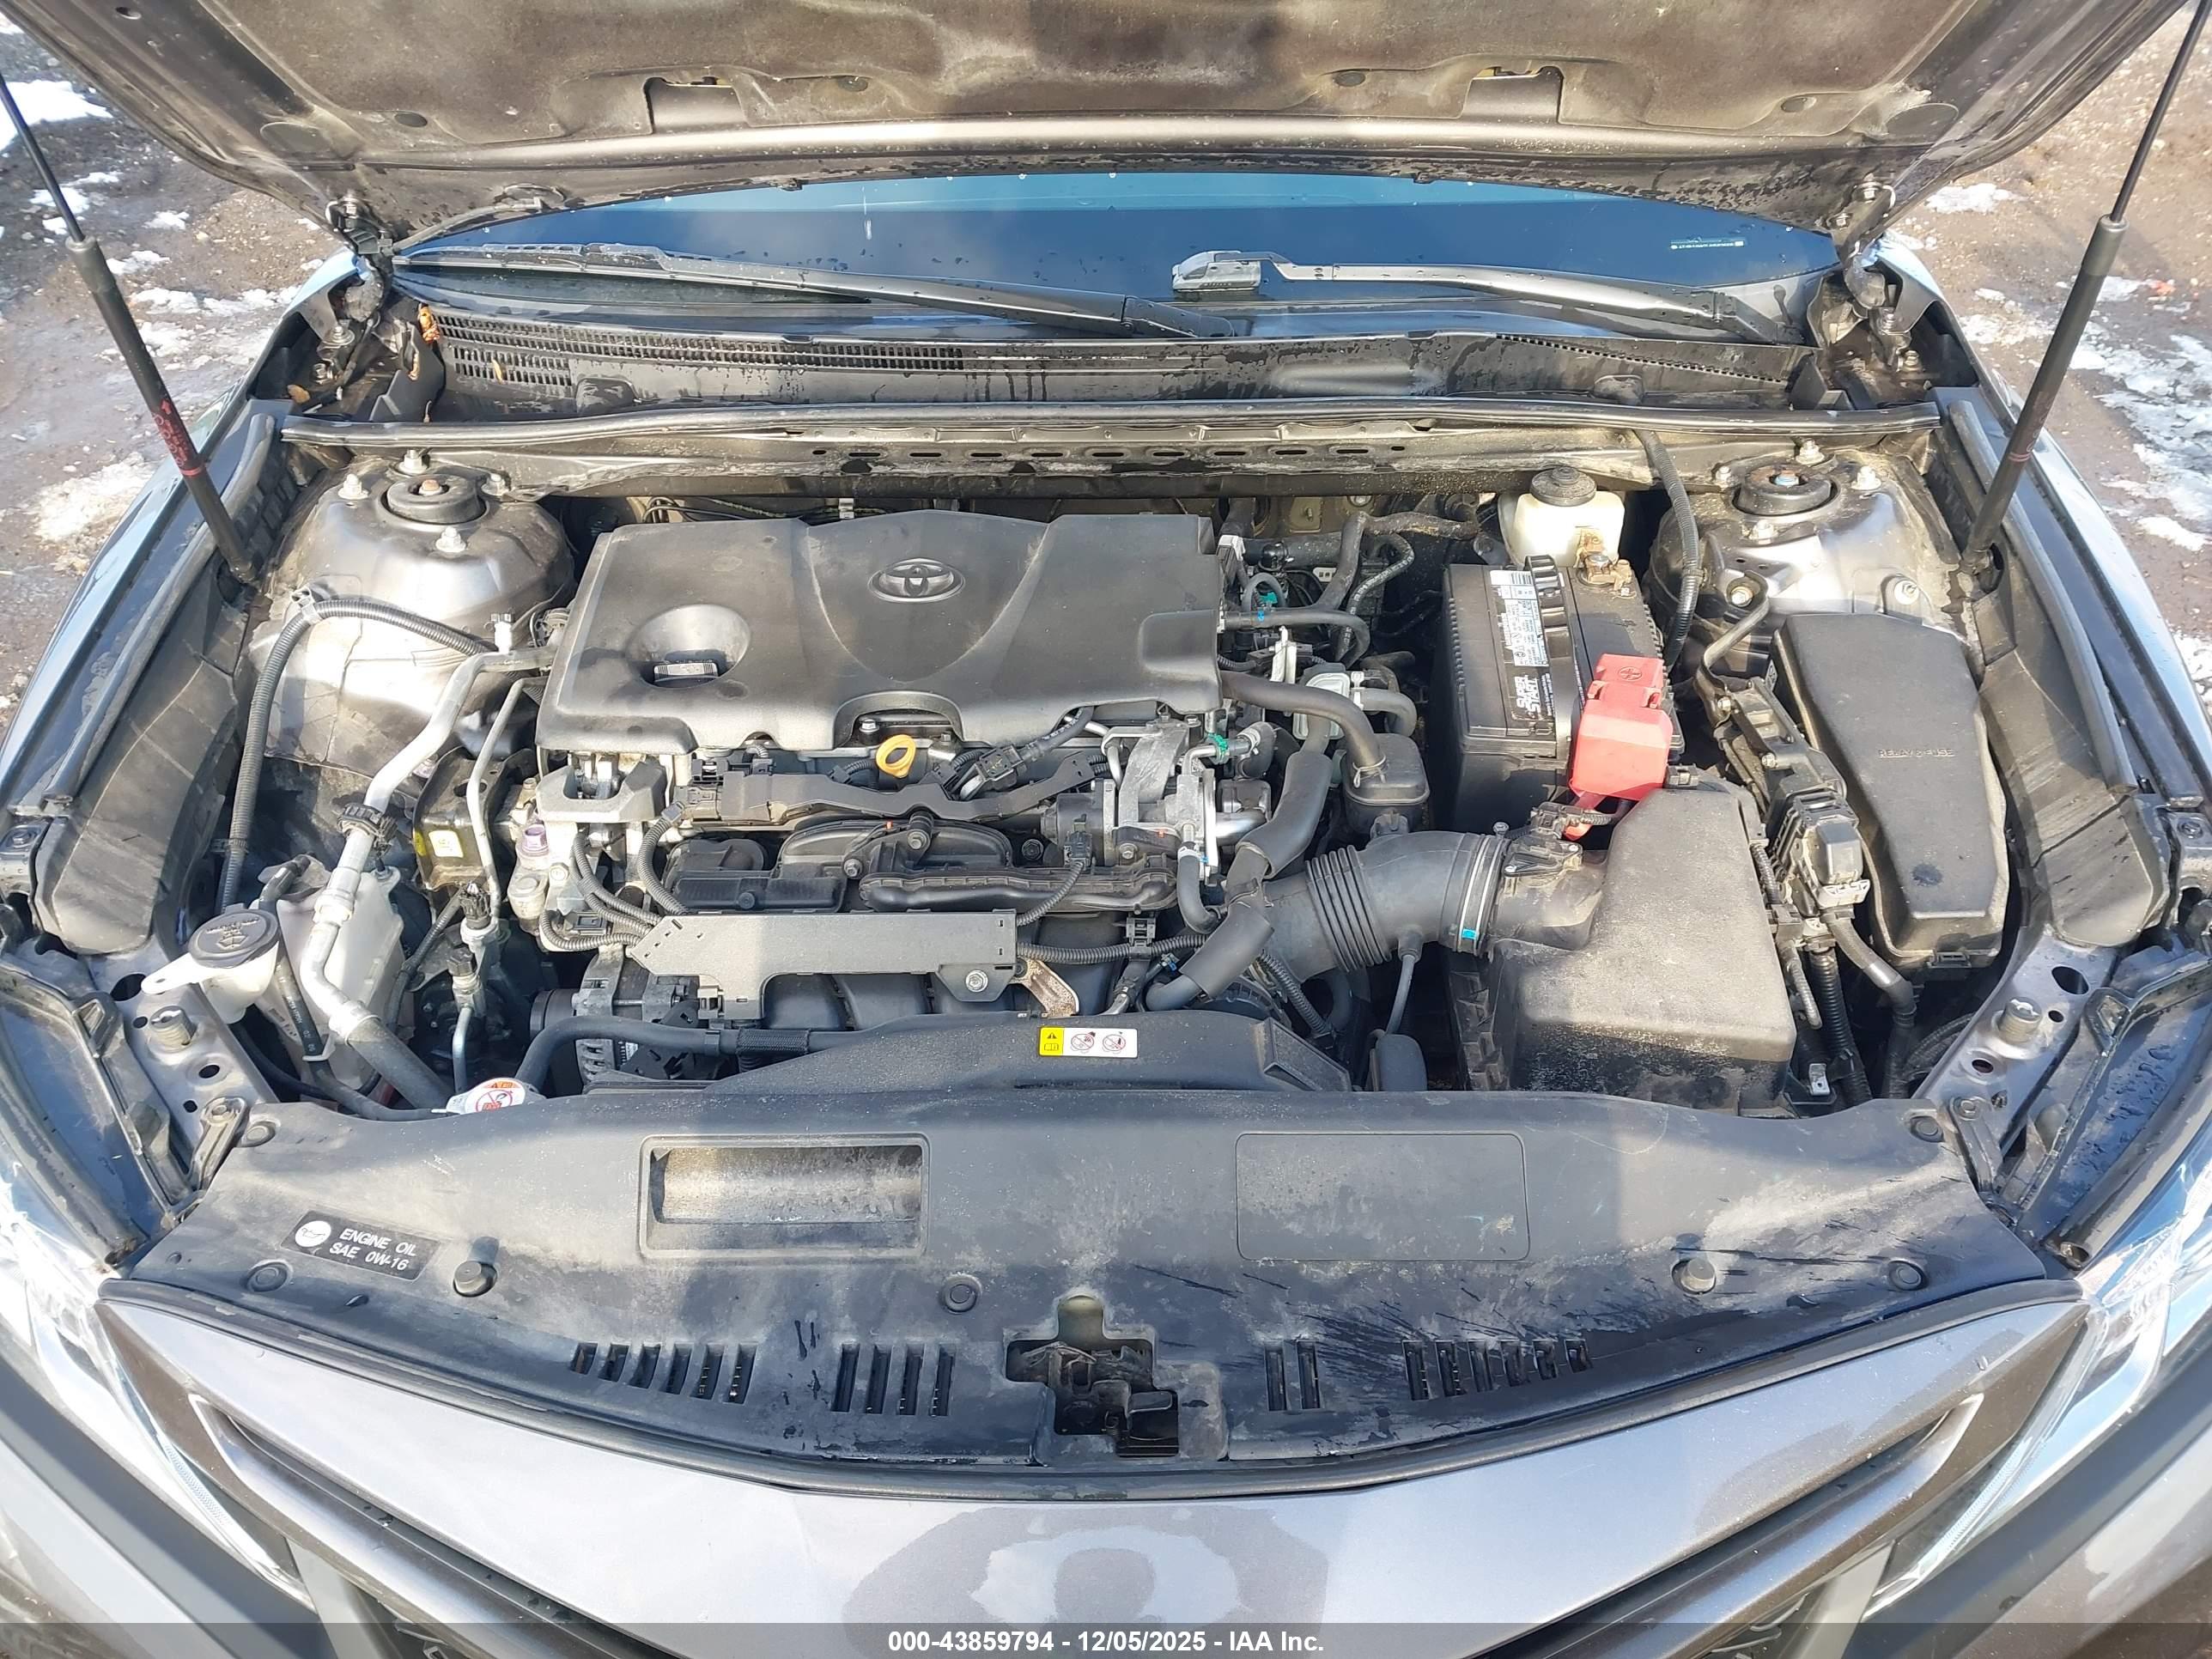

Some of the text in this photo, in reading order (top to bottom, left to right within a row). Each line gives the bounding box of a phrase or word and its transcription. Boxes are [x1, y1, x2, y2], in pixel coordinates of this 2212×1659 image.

[1514, 675, 1528, 708] SUPER
[1524, 678, 1541, 713] START
[1878, 748, 1913, 758] RELAY
[1923, 748, 1955, 757] FUSE
[329, 1242, 410, 1271] SAE 0W-16
[339, 1228, 417, 1256] ENGINE OIL
